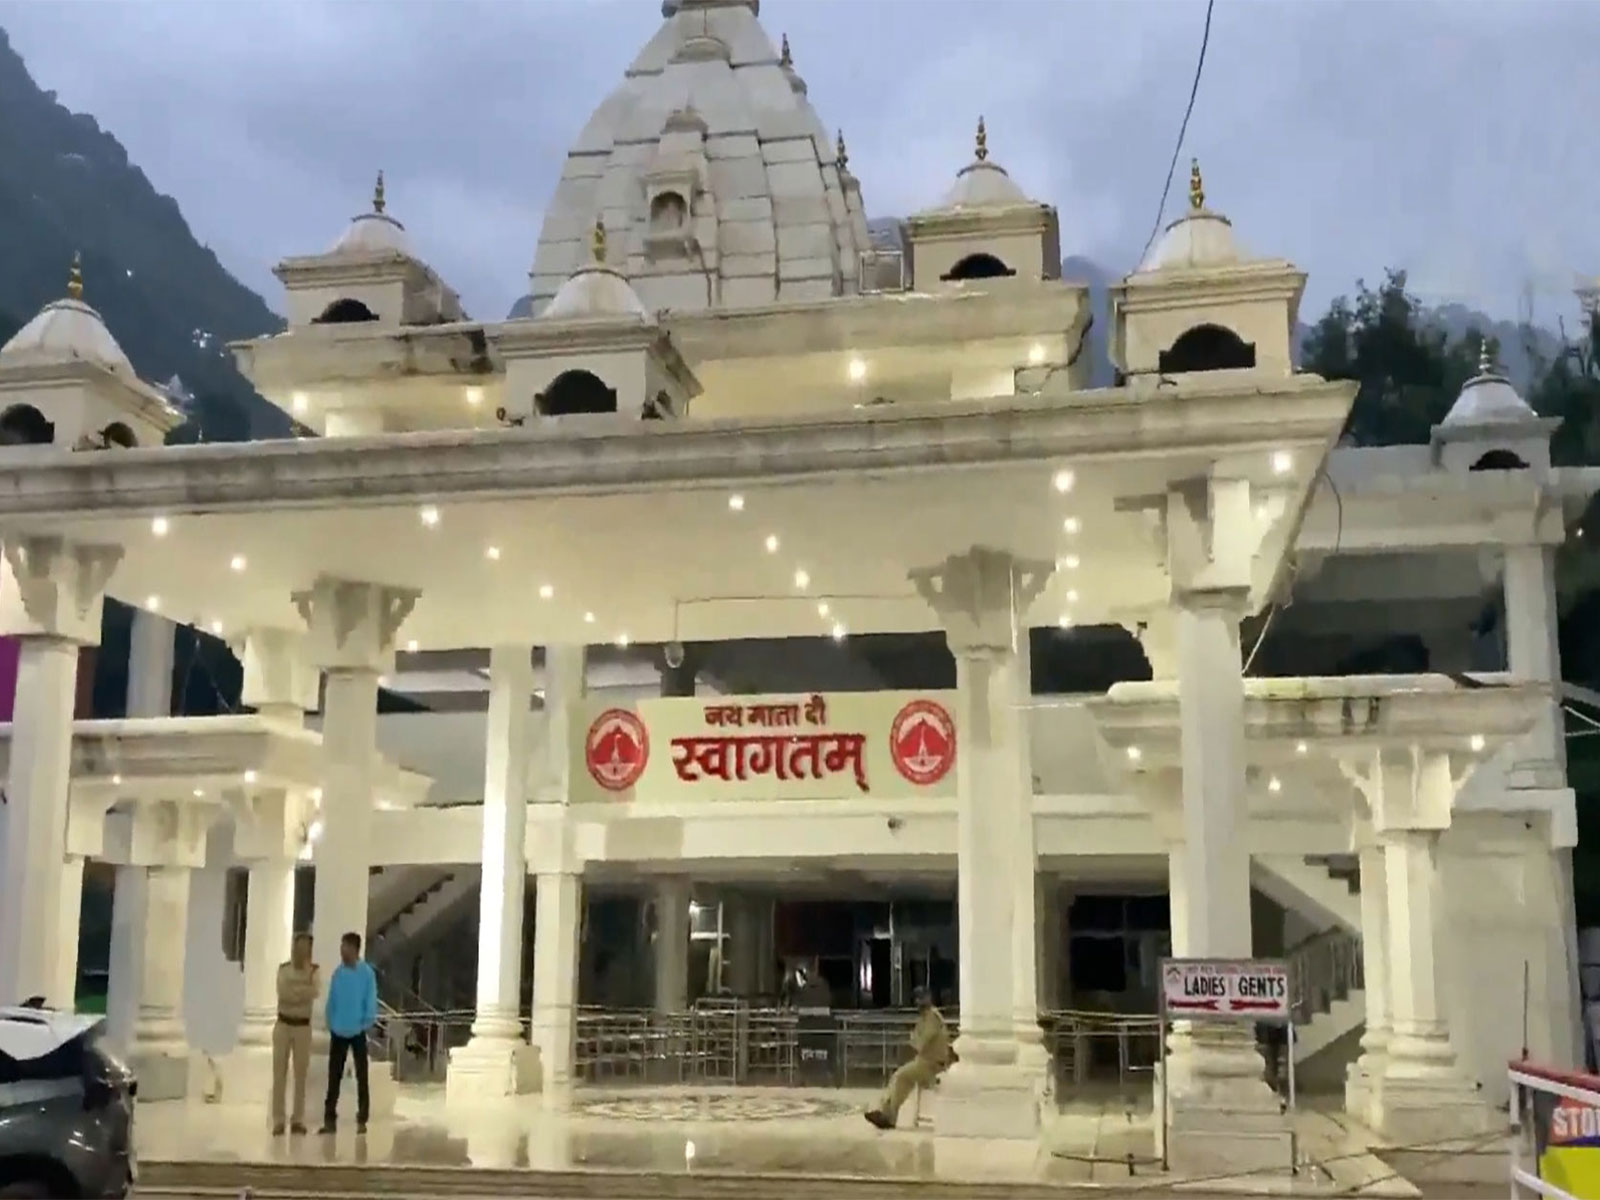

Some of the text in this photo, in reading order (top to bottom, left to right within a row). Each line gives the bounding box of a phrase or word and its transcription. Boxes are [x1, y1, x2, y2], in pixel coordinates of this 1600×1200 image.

[703, 705, 742, 727] जय
[746, 703, 799, 727] माता
[671, 733, 869, 792] स्वागतम्
[1184, 975, 1285, 996] LADIES GENTS
[1552, 1106, 1600, 1137] STO
